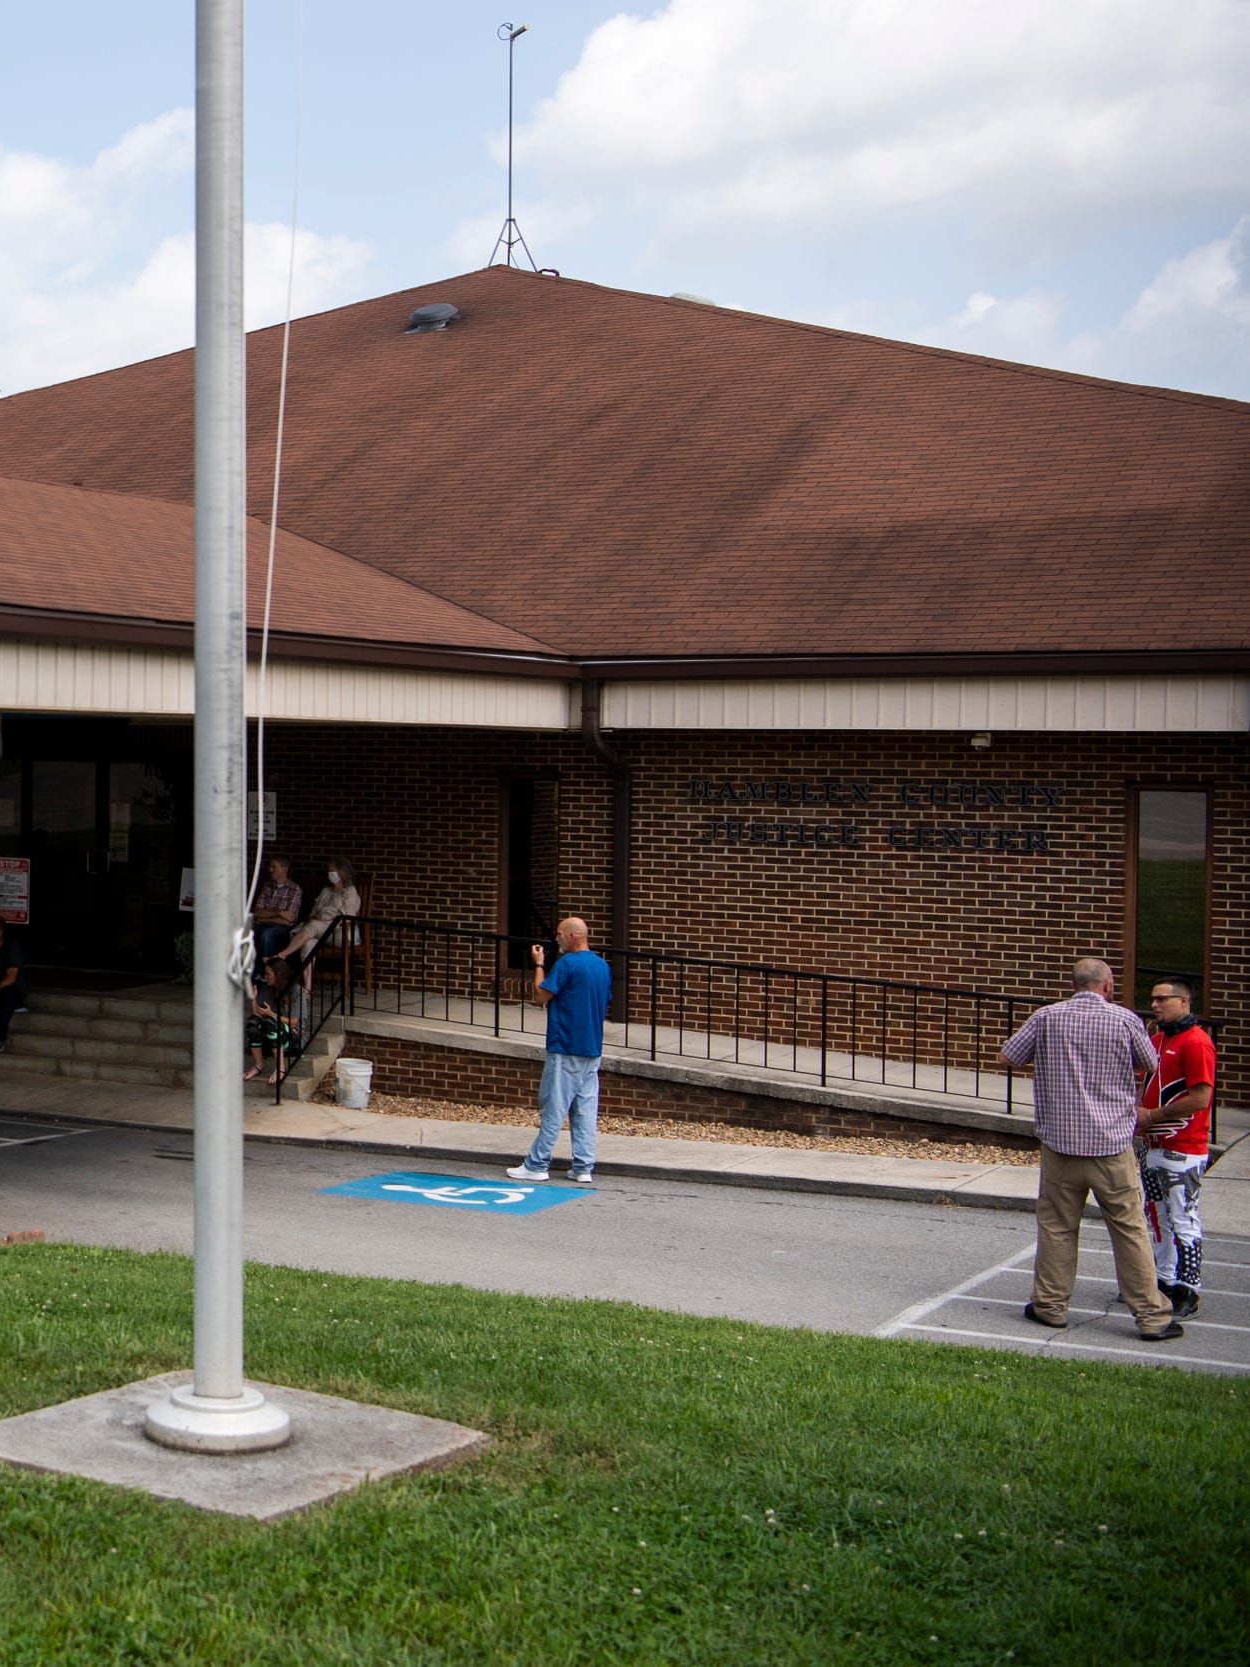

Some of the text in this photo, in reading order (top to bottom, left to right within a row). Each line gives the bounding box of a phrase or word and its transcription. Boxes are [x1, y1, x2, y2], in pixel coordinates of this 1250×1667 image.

[688, 780, 1066, 806] HAMBLEN COUNTY
[702, 822, 1050, 850] JUSTICE CENTER
[0, 860, 21, 868] STOP
